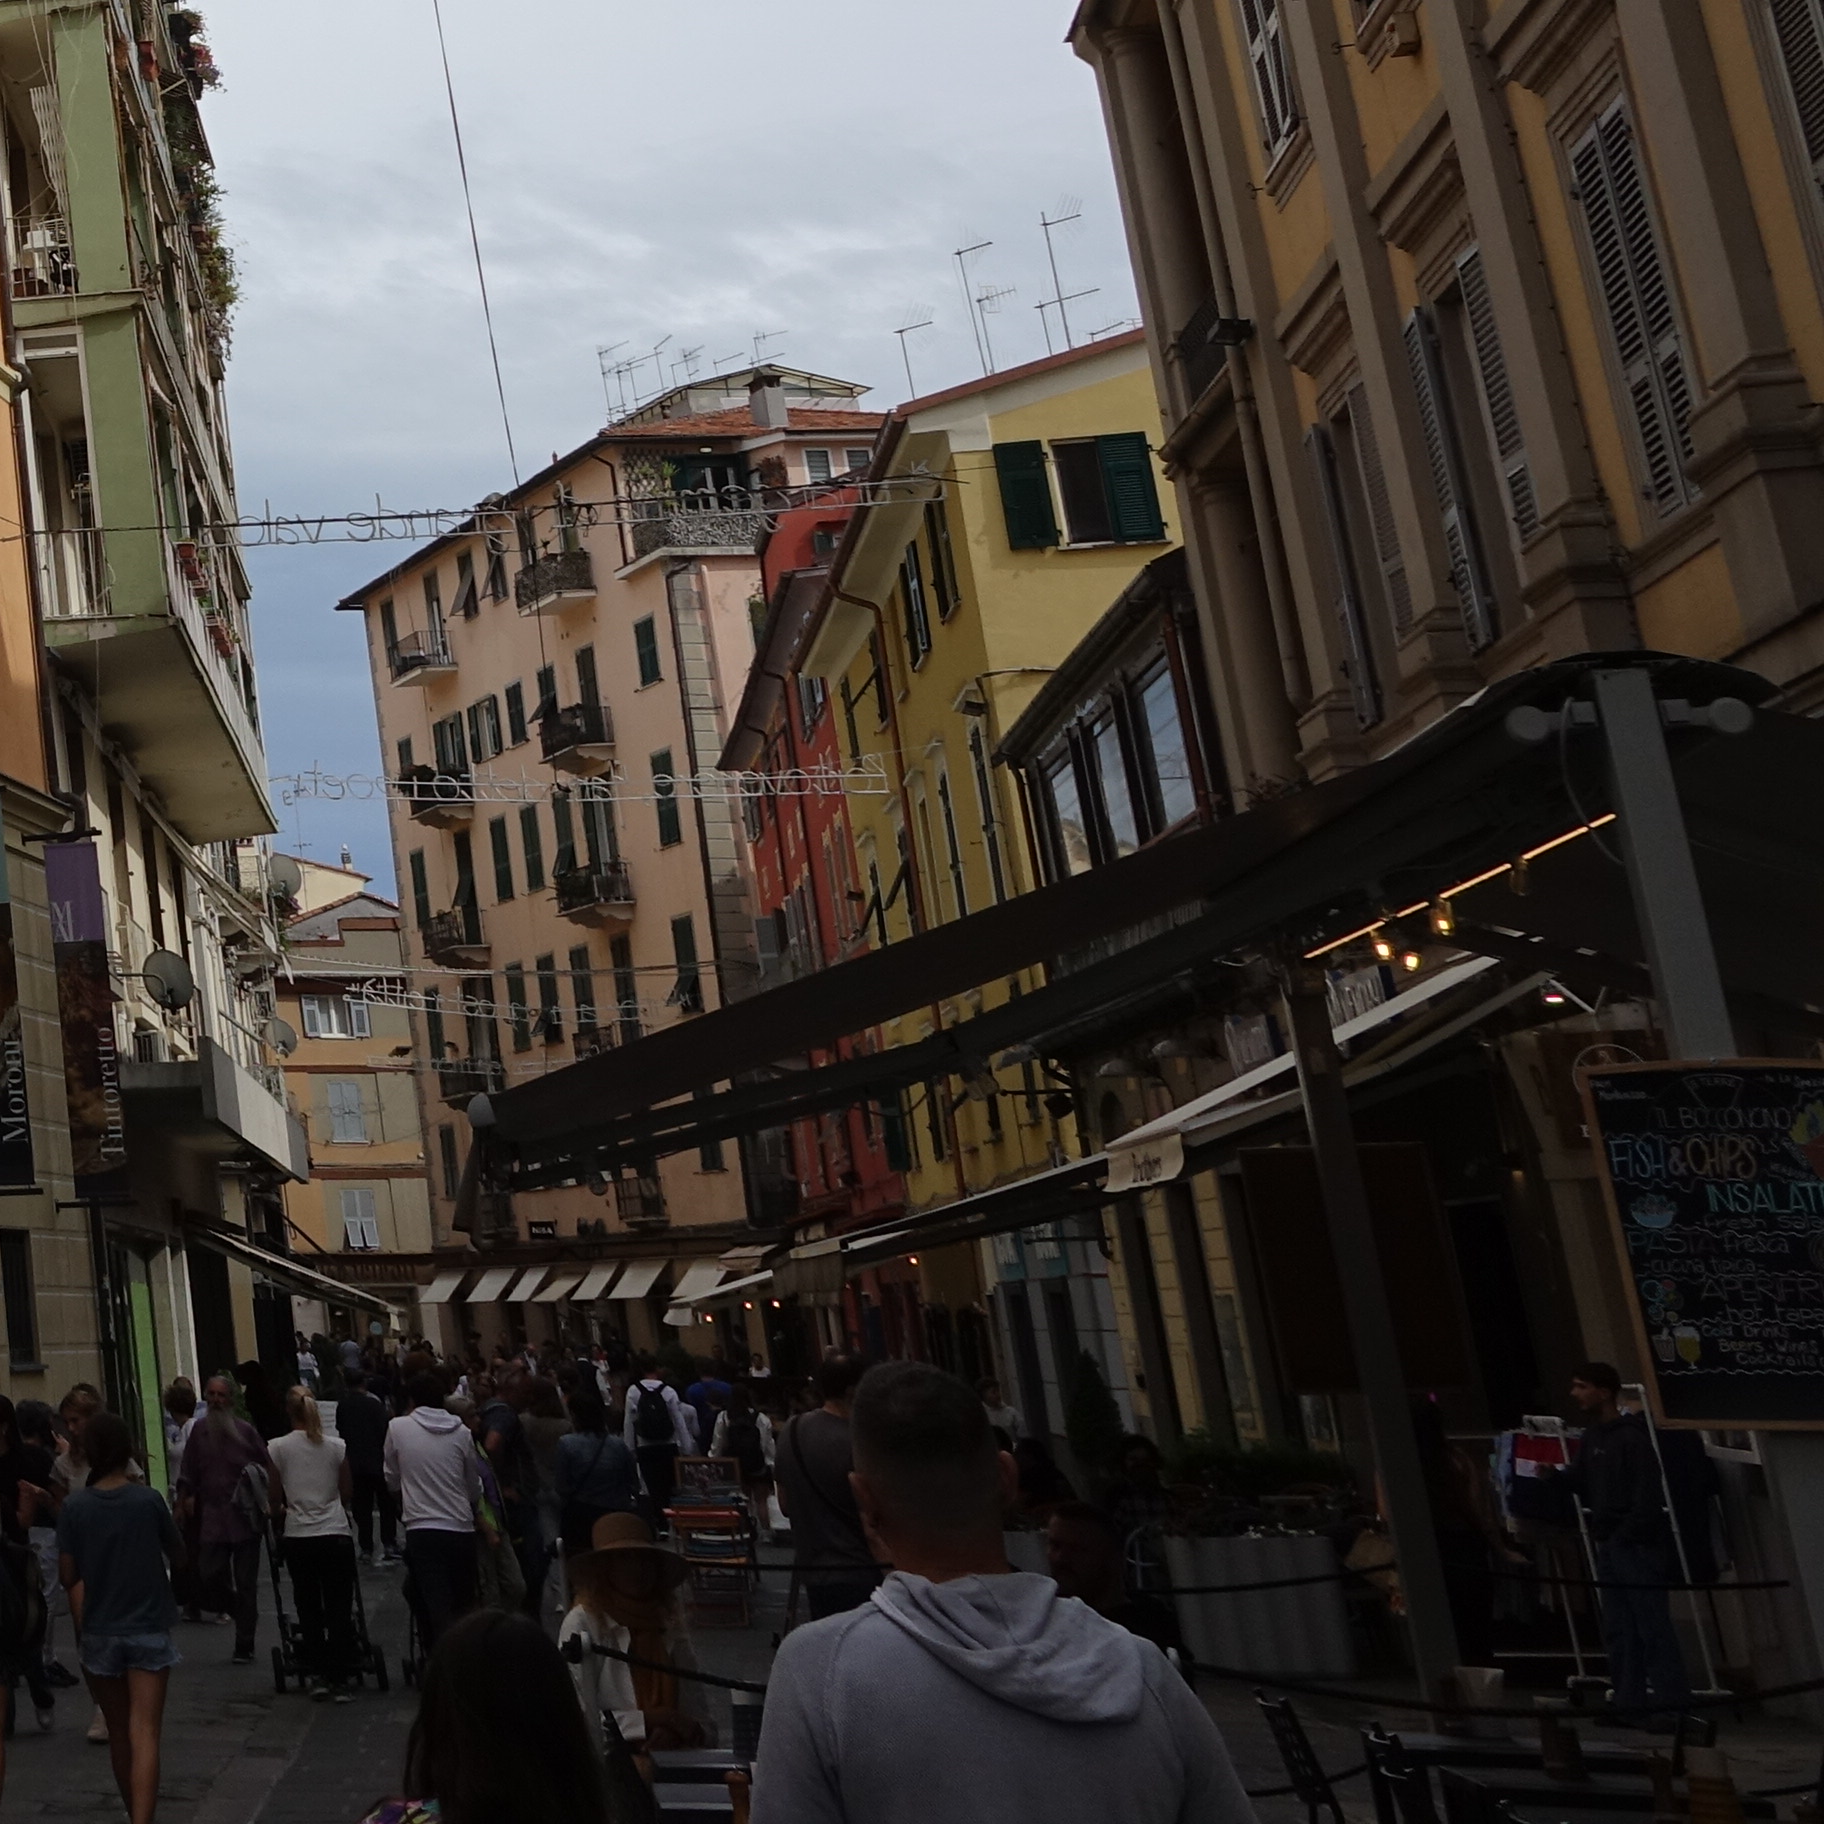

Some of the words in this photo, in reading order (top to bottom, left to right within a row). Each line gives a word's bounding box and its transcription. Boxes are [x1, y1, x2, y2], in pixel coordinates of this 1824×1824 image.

[0, 1037, 32, 1145] Moroni
[98, 1024, 128, 1162] Tintoretto
[1668, 1145, 1689, 1176] &
[1626, 1230, 1719, 1255] PASTA
